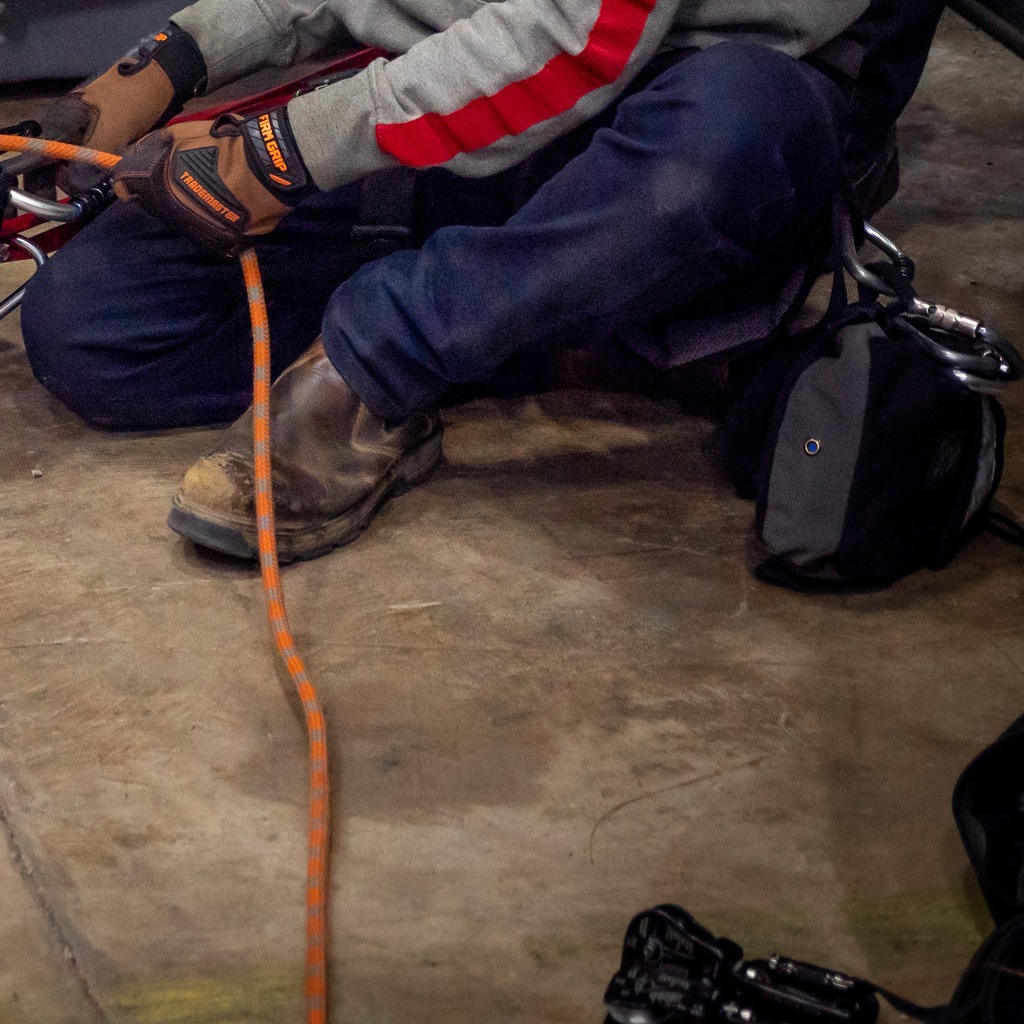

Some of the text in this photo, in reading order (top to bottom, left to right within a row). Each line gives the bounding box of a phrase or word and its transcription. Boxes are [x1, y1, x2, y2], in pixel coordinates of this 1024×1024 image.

[258, 114, 288, 172] FIRM GRIP
[180, 171, 240, 222] TRADEMASTER
